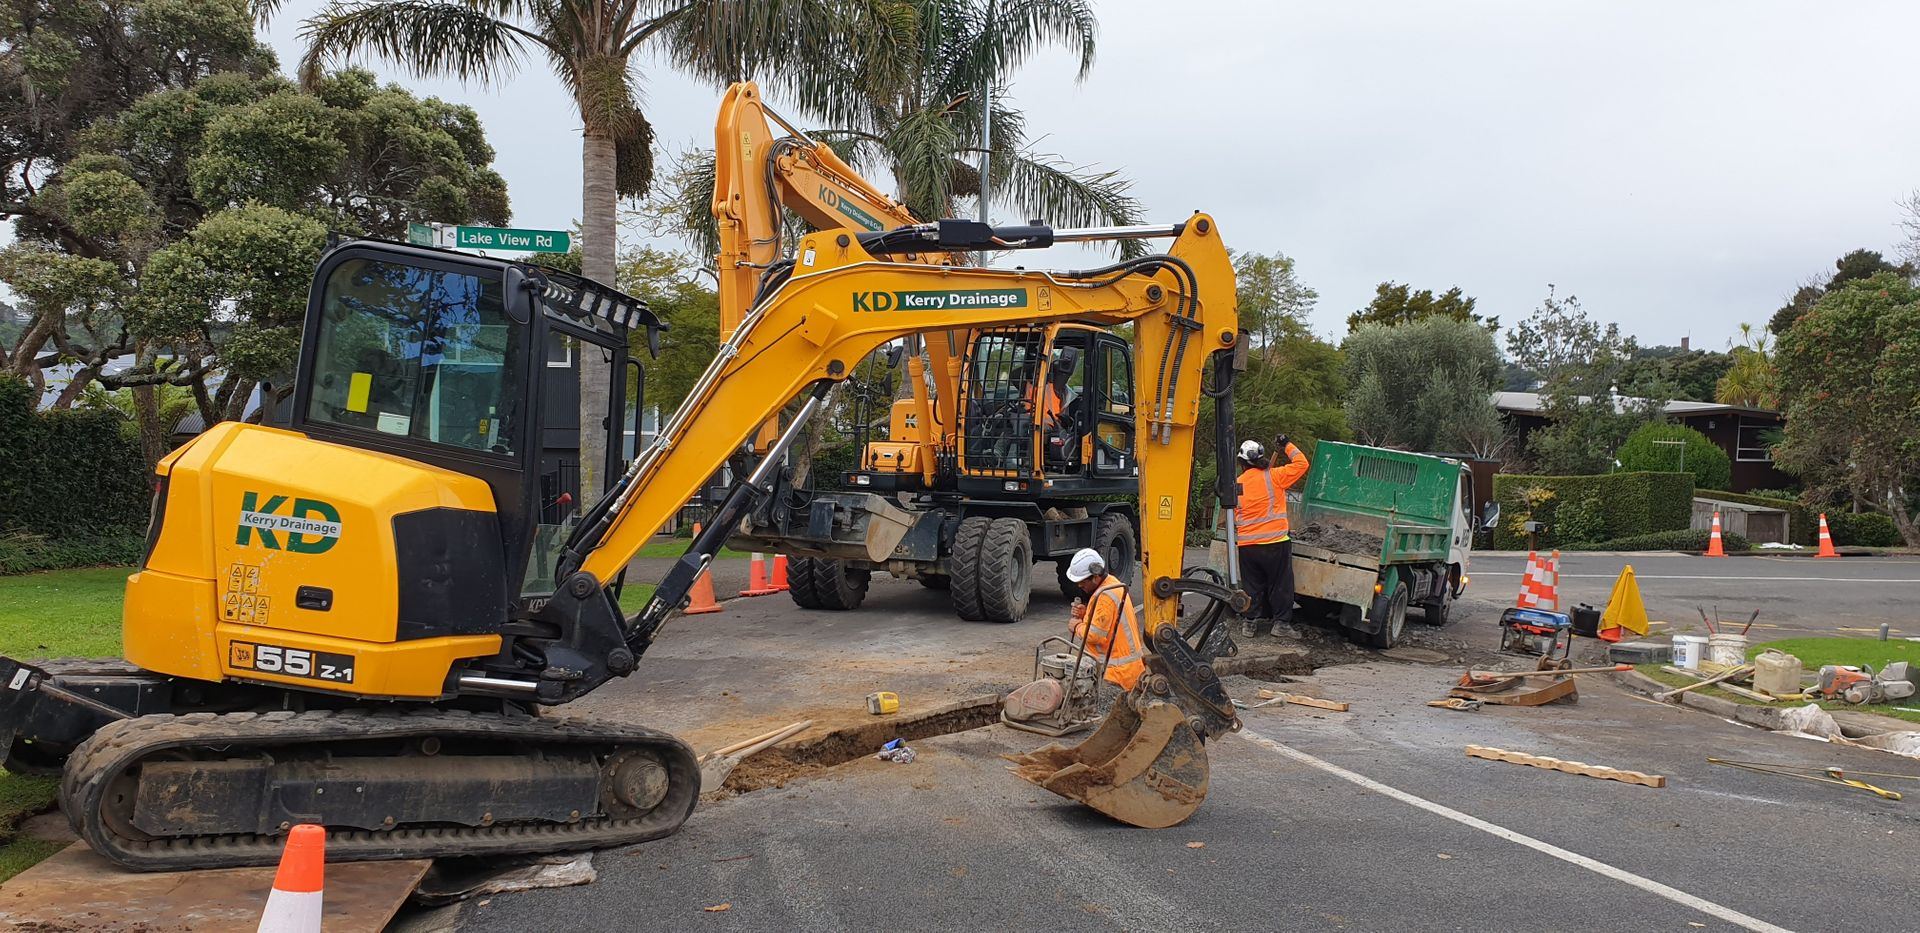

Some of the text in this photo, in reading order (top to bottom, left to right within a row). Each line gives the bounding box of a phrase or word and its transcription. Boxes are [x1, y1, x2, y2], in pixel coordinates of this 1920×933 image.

[819, 184, 837, 207] KD
[461, 231, 553, 247] Lake View Rd
[852, 291, 892, 312] KD
[905, 292, 1018, 308] Kerry Drainage
[235, 491, 341, 554] KD
[244, 513, 337, 535] Kerry Drainage
[256, 645, 353, 681] 55 Z-1
